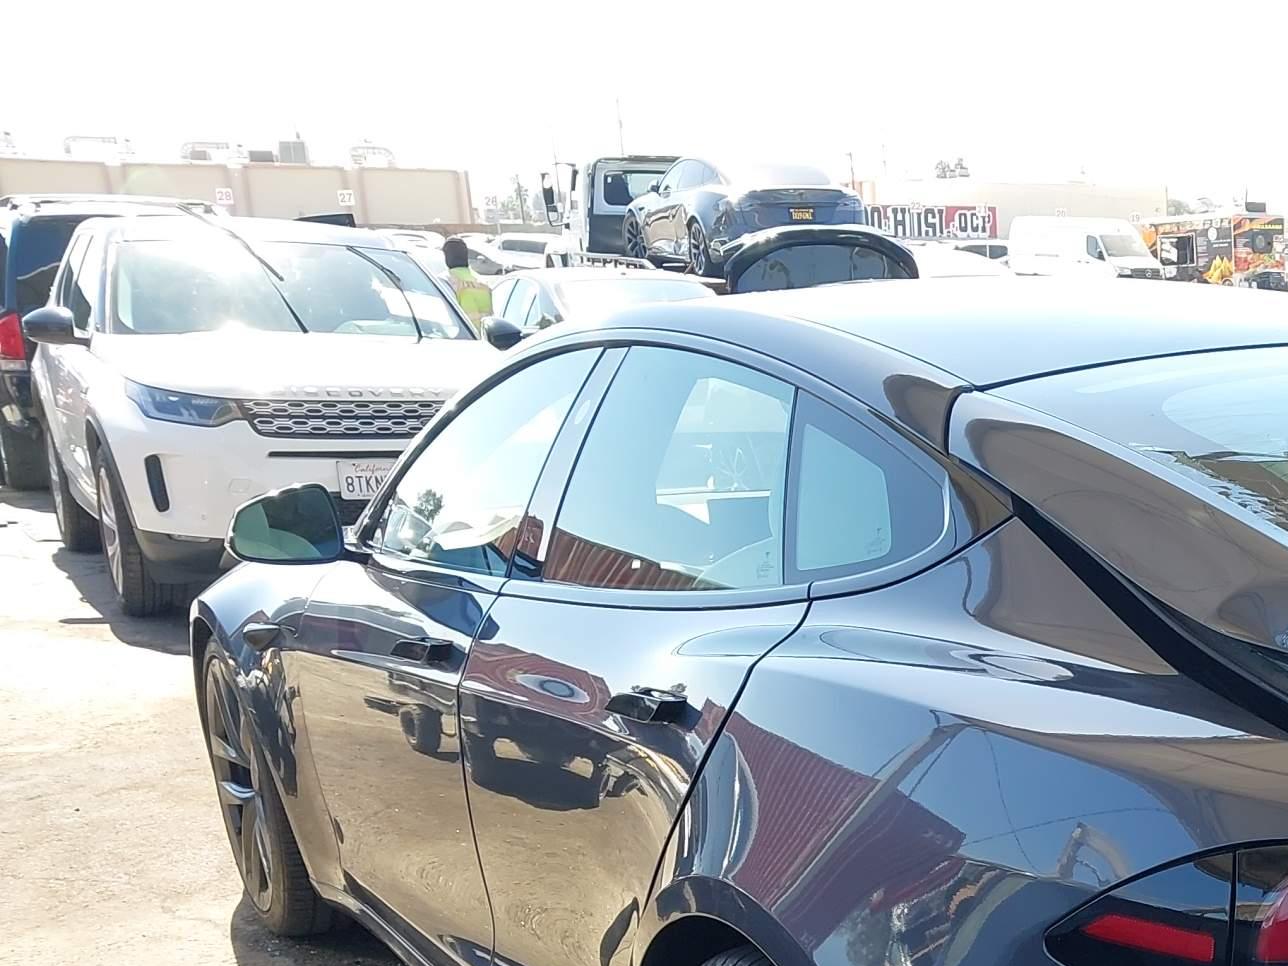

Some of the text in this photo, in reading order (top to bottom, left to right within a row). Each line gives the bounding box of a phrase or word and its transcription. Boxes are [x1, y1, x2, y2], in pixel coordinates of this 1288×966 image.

[217, 190, 232, 201] 28
[338, 192, 353, 203] 27
[345, 475, 387, 494] 8TKN
